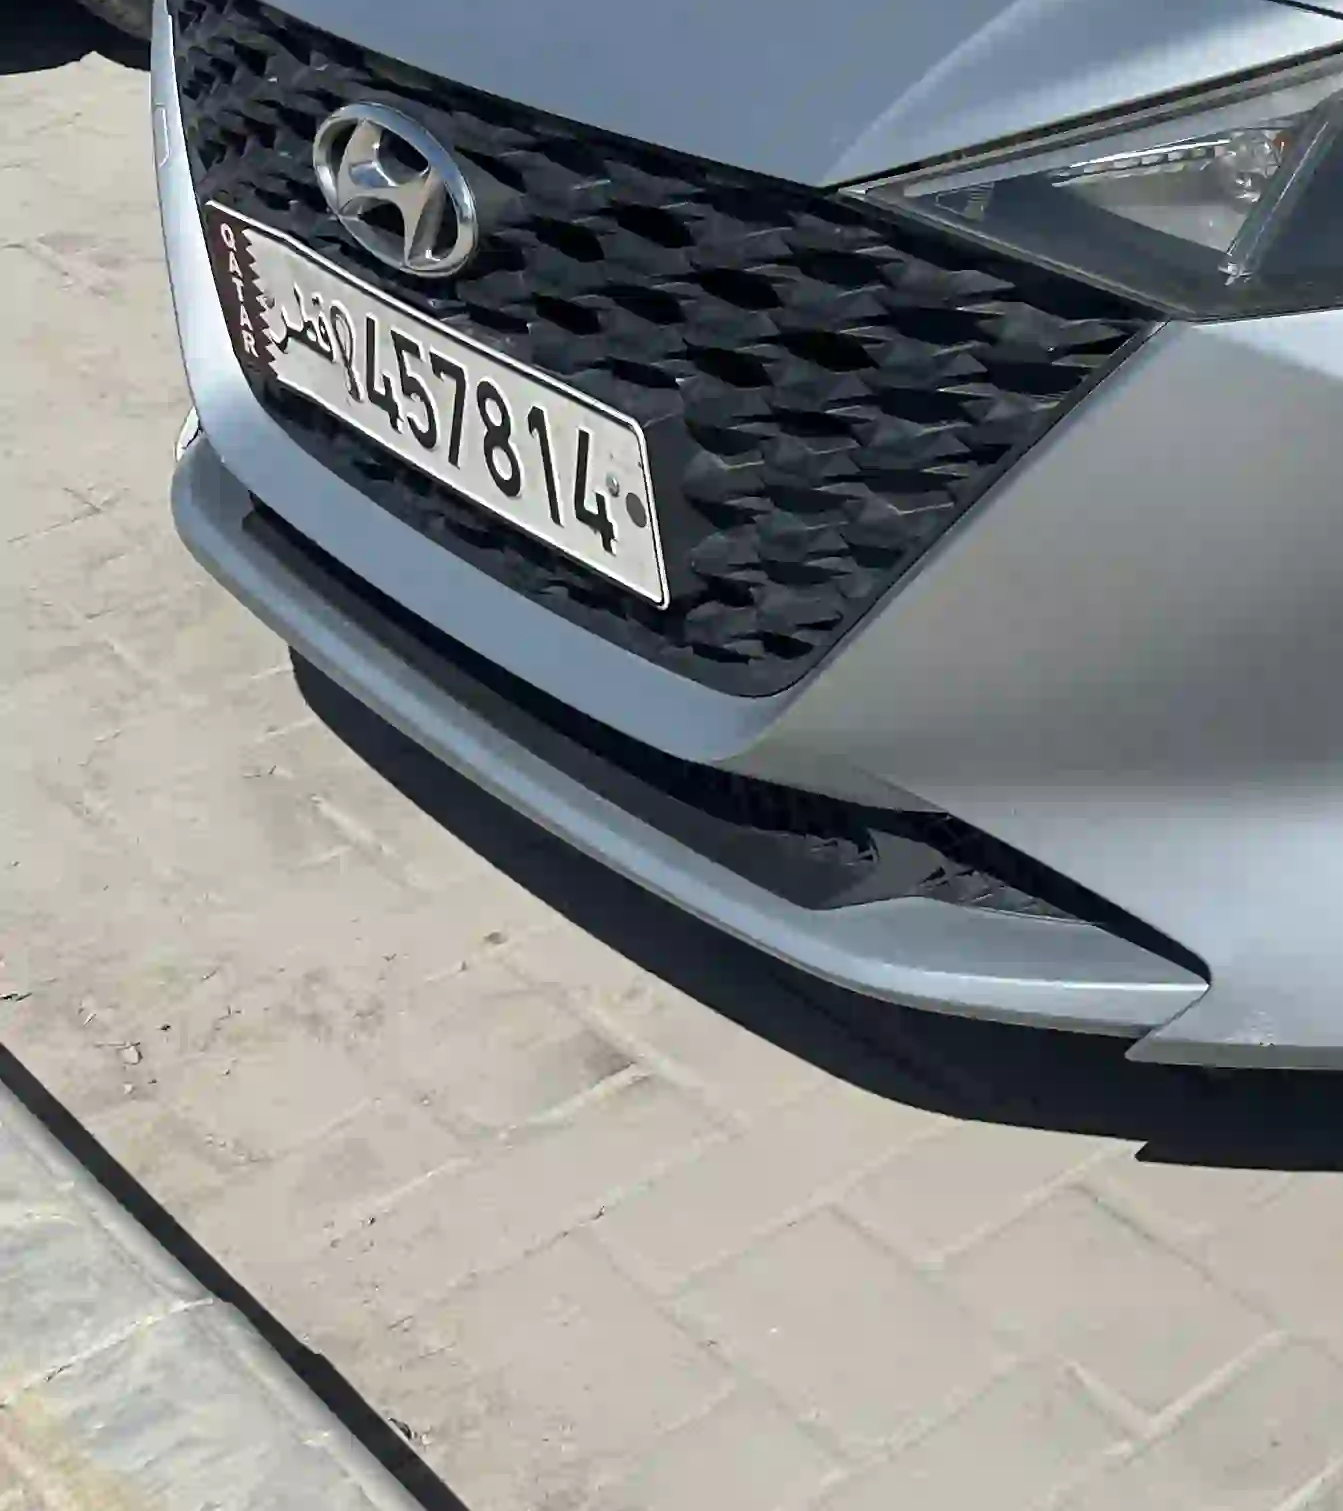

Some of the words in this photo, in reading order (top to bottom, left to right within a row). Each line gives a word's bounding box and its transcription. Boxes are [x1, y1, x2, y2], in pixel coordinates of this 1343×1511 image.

[218, 221, 259, 358] QATAR
[265, 283, 338, 365] قطر
[364, 312, 621, 557] 457814
